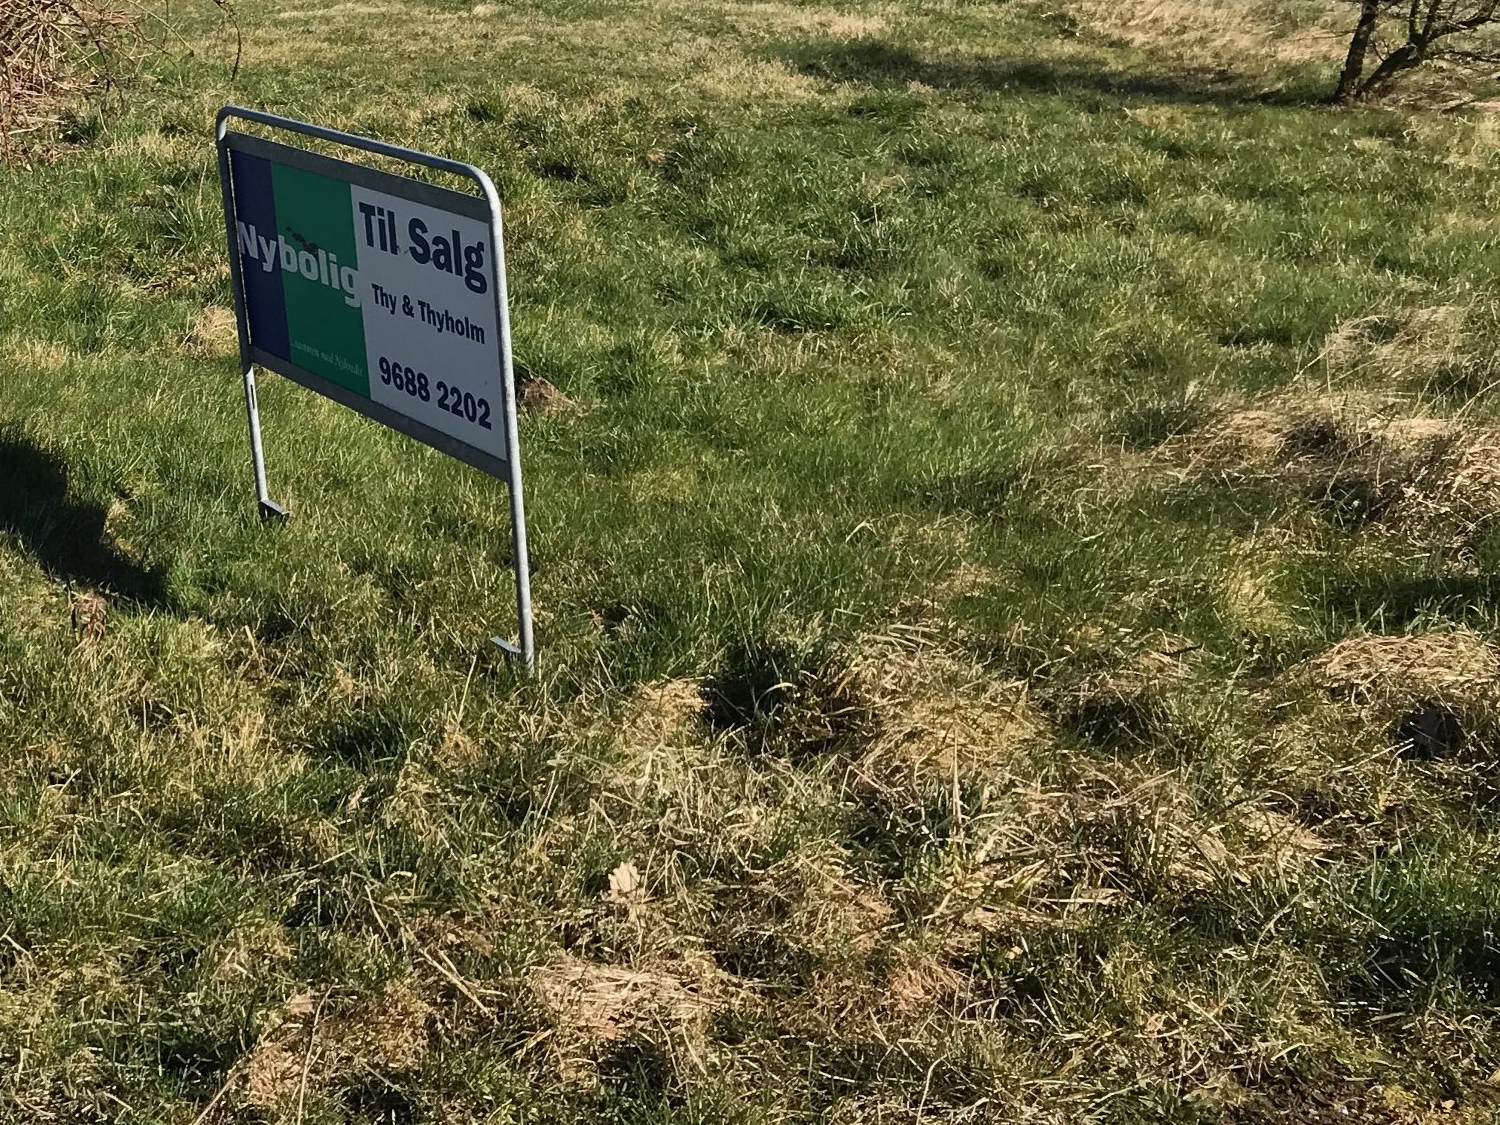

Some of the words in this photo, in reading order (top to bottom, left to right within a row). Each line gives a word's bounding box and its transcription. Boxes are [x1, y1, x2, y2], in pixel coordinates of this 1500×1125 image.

[237, 221, 362, 308] Nybolig
[359, 202, 398, 255] Til
[408, 217, 488, 295] Salg
[372, 283, 397, 315] Thy
[402, 295, 416, 318] &
[418, 300, 486, 345] Thyholm
[379, 356, 431, 403] 9688
[436, 381, 492, 430] 2202
